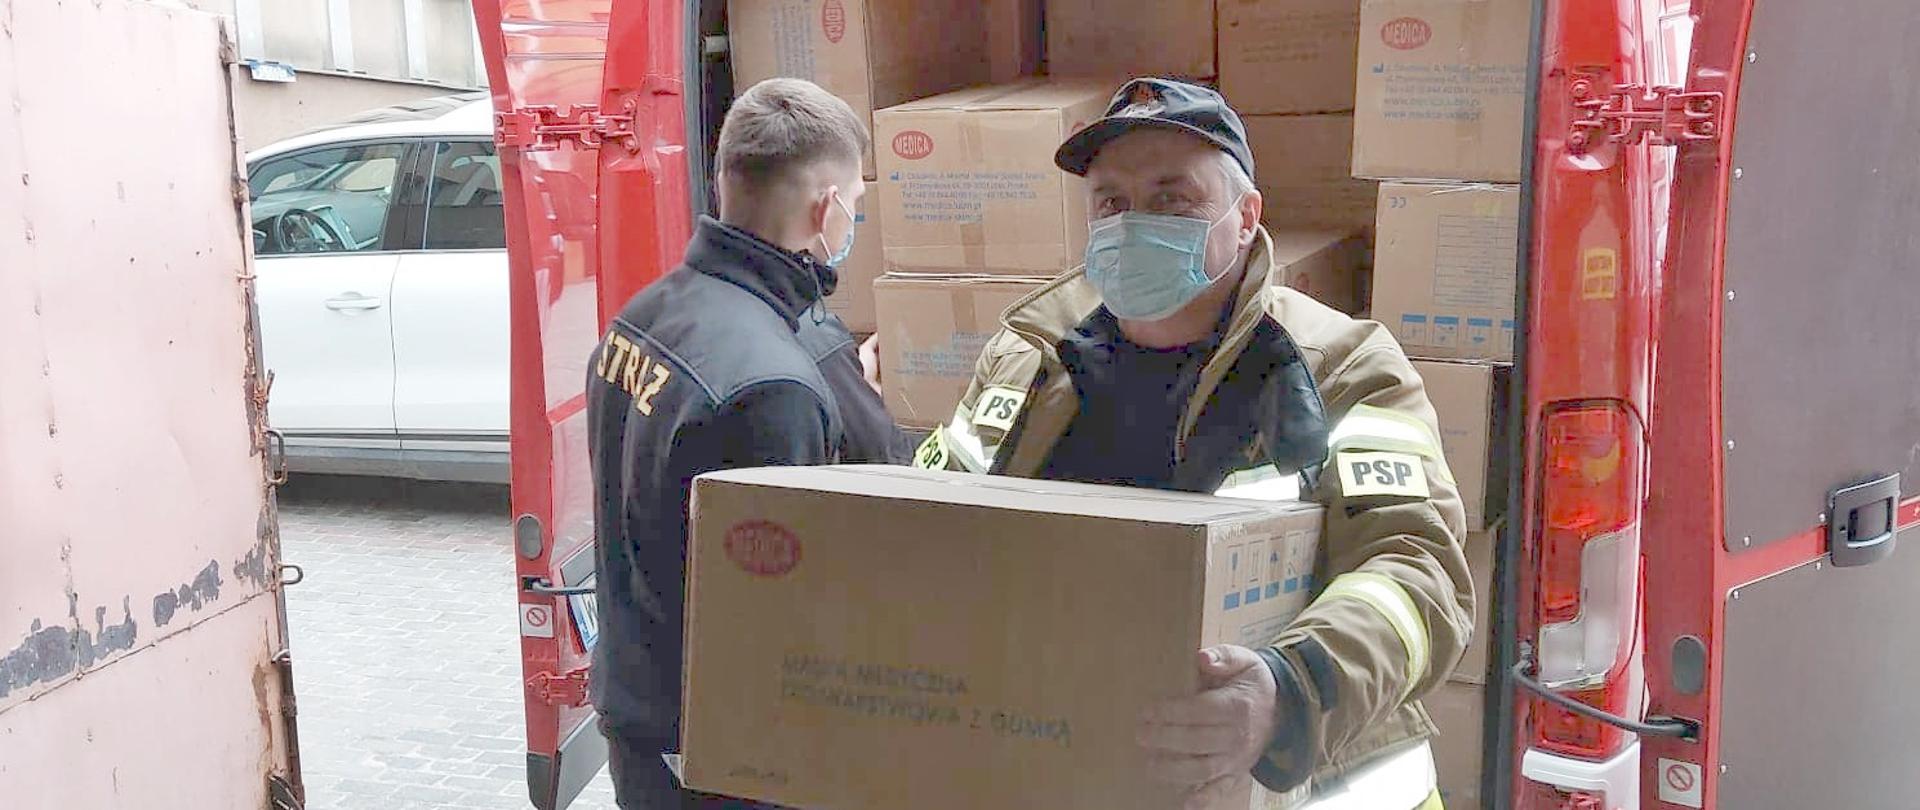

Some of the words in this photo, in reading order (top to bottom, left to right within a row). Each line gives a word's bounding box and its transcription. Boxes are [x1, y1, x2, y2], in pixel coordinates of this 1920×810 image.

[1384, 21, 1427, 45] MEDICA
[893, 132, 932, 156] MEDICA
[983, 394, 1018, 423] PS
[1351, 460, 1413, 486] PSP
